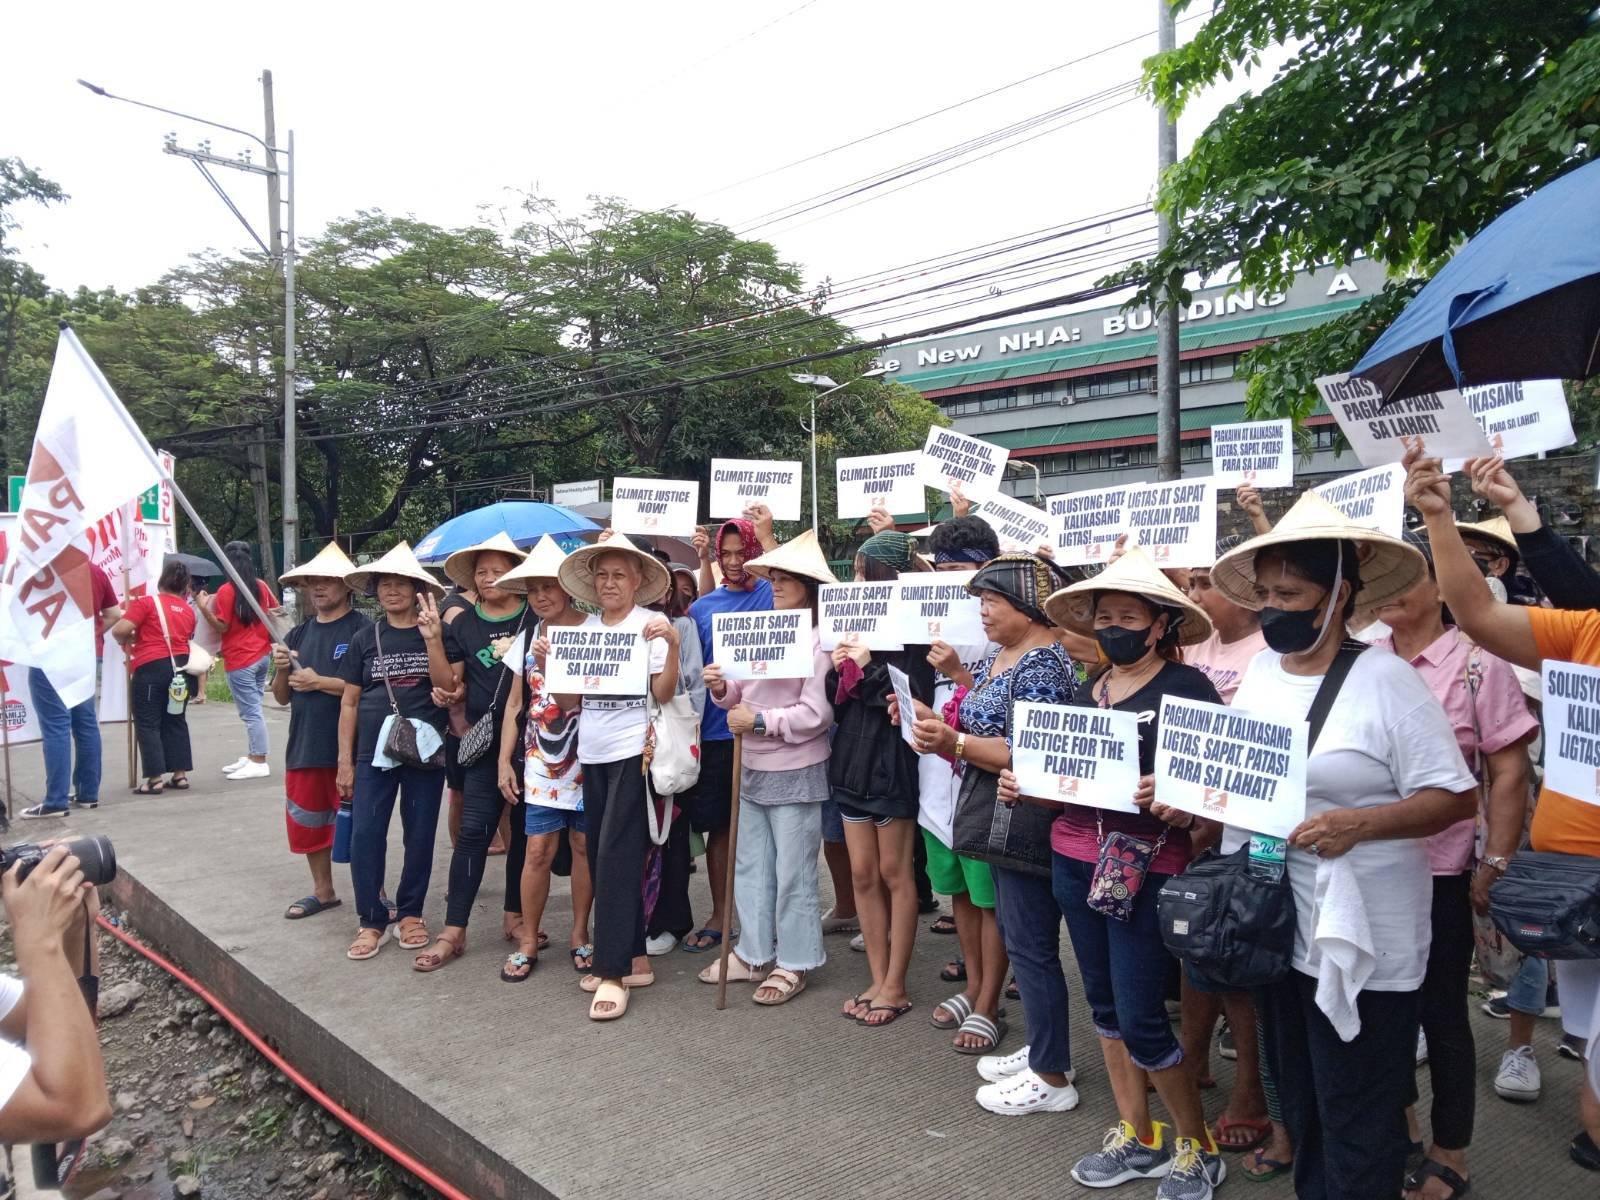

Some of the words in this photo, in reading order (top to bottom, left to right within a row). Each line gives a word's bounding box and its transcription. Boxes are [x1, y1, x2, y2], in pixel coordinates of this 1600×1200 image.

[918, 344, 982, 366] New
[999, 326, 1082, 353] NHA:
[1103, 288, 1287, 336] BUDING
[1326, 272, 1358, 296] A
[1325, 379, 1373, 402] LIGTAS
[1464, 381, 1524, 414] IKASANG
[1242, 428, 1249, 440] AT
[1250, 425, 1284, 440] KALIKASANG
[1369, 419, 1392, 440] SA
[1390, 414, 1440, 437] LAHAT!
[1490, 423, 1506, 434] PARA
[1508, 420, 1516, 430] SA
[1517, 412, 1540, 428] LAHAT!
[936, 433, 961, 449] FOOD
[960, 440, 978, 455] FOR
[976, 446, 992, 461] ALL,
[1216, 444, 1238, 457] LIGTAS,
[1262, 441, 1284, 454] PATAS!
[927, 444, 963, 464] JUSTICE
[962, 455, 980, 470] FOR
[980, 461, 996, 476] THE
[1222, 458, 1240, 471] PARA
[1242, 458, 1252, 470] SA
[1254, 456, 1279, 470] LAHAT!
[714, 470, 754, 482] CLIMATE
[754, 472, 793, 484] JUSTICE
[840, 467, 878, 482] CLIMATE
[879, 463, 916, 478] JUSTICE
[940, 463, 976, 483] PLANET!
[738, 484, 769, 496] NOW!
[864, 480, 894, 494] NOW!
[1358, 471, 1392, 496] PATAS
[616, 488, 653, 500] CLIMATE
[654, 490, 690, 502] JUSTICE
[1051, 494, 1103, 516] SOLUSYONG
[1128, 489, 1158, 508] LIGTAS
[1159, 488, 1172, 505] AT
[1173, 484, 1206, 504] SAPAT
[638, 502, 667, 514] NOW!
[983, 500, 1027, 526] CLIMATE
[1129, 508, 1172, 527] PAGKAIN
[1173, 505, 1200, 524] PARA
[1064, 508, 1120, 530] KALIKASANG
[999, 523, 1035, 544] NOW!
[1058, 530, 1092, 548] LIGTAS!
[1138, 528, 1151, 546] SA
[1153, 526, 1188, 544] LAHAT!
[821, 588, 850, 602] LIGTAS
[850, 587, 861, 600] AT
[862, 586, 893, 600] SAPAT
[901, 586, 934, 600] CLIMATE
[824, 602, 860, 617] PAGKAIN
[862, 602, 888, 616] PARA
[920, 602, 949, 617] NOW!
[717, 617, 751, 632] LIGTAS
[753, 616, 766, 630] AT
[768, 614, 800, 629] SAPAT
[832, 618, 842, 632] SA
[844, 618, 876, 632] LAHAT!
[551, 632, 588, 645] LIGTAS
[589, 632, 602, 646] AT
[604, 633, 638, 646] SAPAT
[722, 632, 766, 646] PAGKAIN
[769, 630, 796, 644] PARA
[556, 647, 602, 660] PAGKAIN
[604, 648, 631, 662] PARA
[734, 648, 747, 662] SA
[750, 646, 785, 662] LAHAT!
[567, 662, 580, 676] SA
[583, 663, 620, 676] LAHAT!
[1026, 709, 1060, 730] FOOD
[1062, 713, 1088, 734] FOR
[1090, 716, 1114, 738] ALL,
[1212, 712, 1228, 736] AT
[1226, 716, 1292, 751] KALIKASANG
[1018, 730, 1070, 754] JUSTICE
[1071, 736, 1098, 757] FOR
[1100, 739, 1124, 761] THE
[1162, 728, 1201, 760] LIGTAS,
[1204, 738, 1245, 769] SAPAT,
[1245, 747, 1290, 778] PATAS!
[1044, 754, 1098, 780] PLANET!
[1168, 756, 1200, 785] PARA
[1204, 765, 1222, 790] SA
[1224, 770, 1278, 802] LAHAT!
